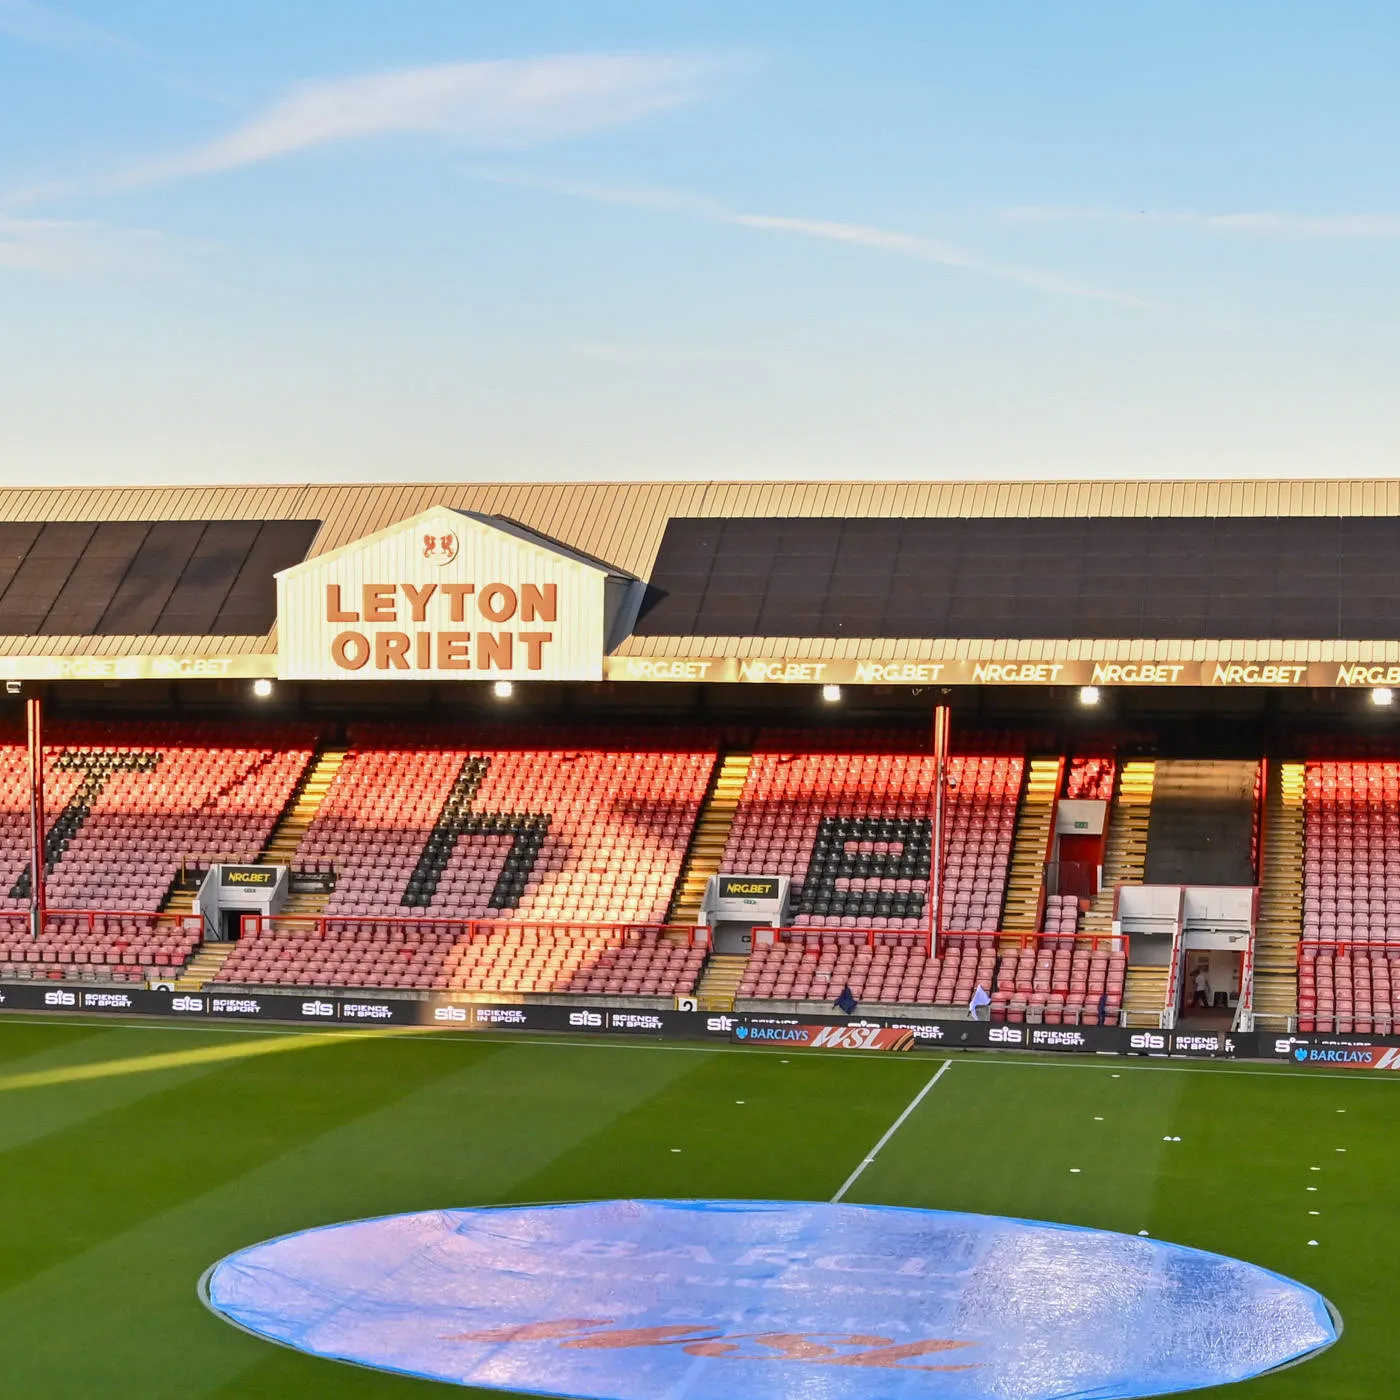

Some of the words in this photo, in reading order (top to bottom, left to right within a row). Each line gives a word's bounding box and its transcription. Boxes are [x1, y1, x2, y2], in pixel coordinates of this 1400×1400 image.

[326, 582, 557, 623] LEYTON
[331, 630, 553, 671] ORIENT
[85, 994, 128, 1003] SCIENCE
[86, 999, 96, 1007] IN
[98, 1000, 132, 1008] SPORT
[213, 999, 257, 1009] SCIENCE
[344, 1004, 389, 1014] SCIENCE
[226, 1006, 261, 1014] SPORT
[344, 1010, 355, 1018] IN
[357, 1010, 393, 1019] SPORT
[612, 1014, 660, 1024] SCIENCE
[612, 1020, 624, 1028] IN
[626, 1021, 664, 1029] SPORT
[751, 1026, 809, 1042] BARCLAYS
[810, 1026, 885, 1050] WSL
[1033, 1031, 1081, 1040] SCIENCE
[1033, 1036, 1045, 1044] IN
[1047, 1037, 1085, 1046] SPORT
[1309, 1048, 1372, 1064] BARCLAYS
